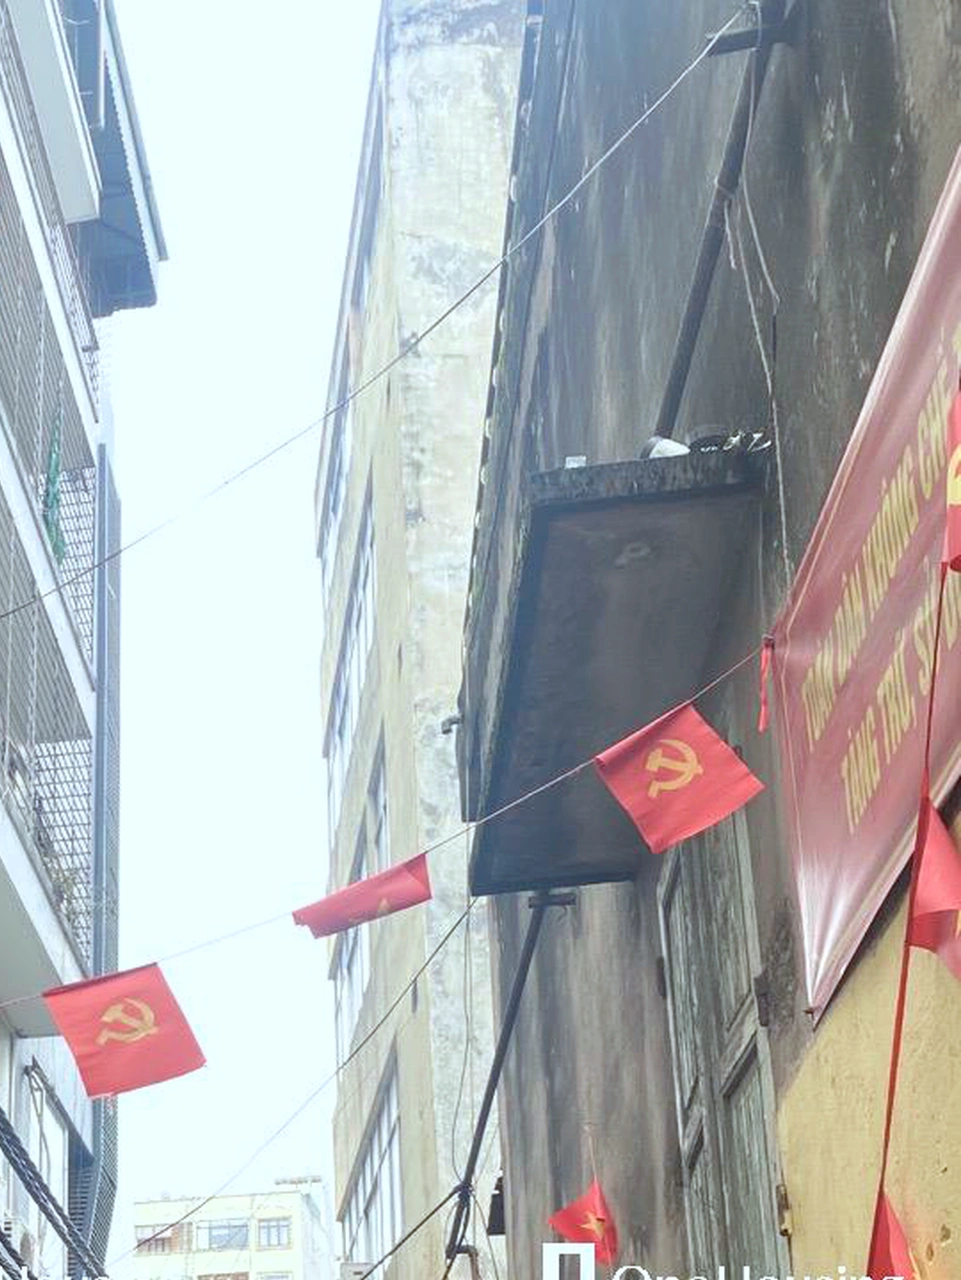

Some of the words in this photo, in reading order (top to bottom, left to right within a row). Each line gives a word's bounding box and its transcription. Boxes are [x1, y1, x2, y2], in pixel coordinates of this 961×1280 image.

[833, 563, 867, 687] DÂN
[862, 444, 919, 622] KHÔNG
[841, 705, 880, 835] TÀNG
